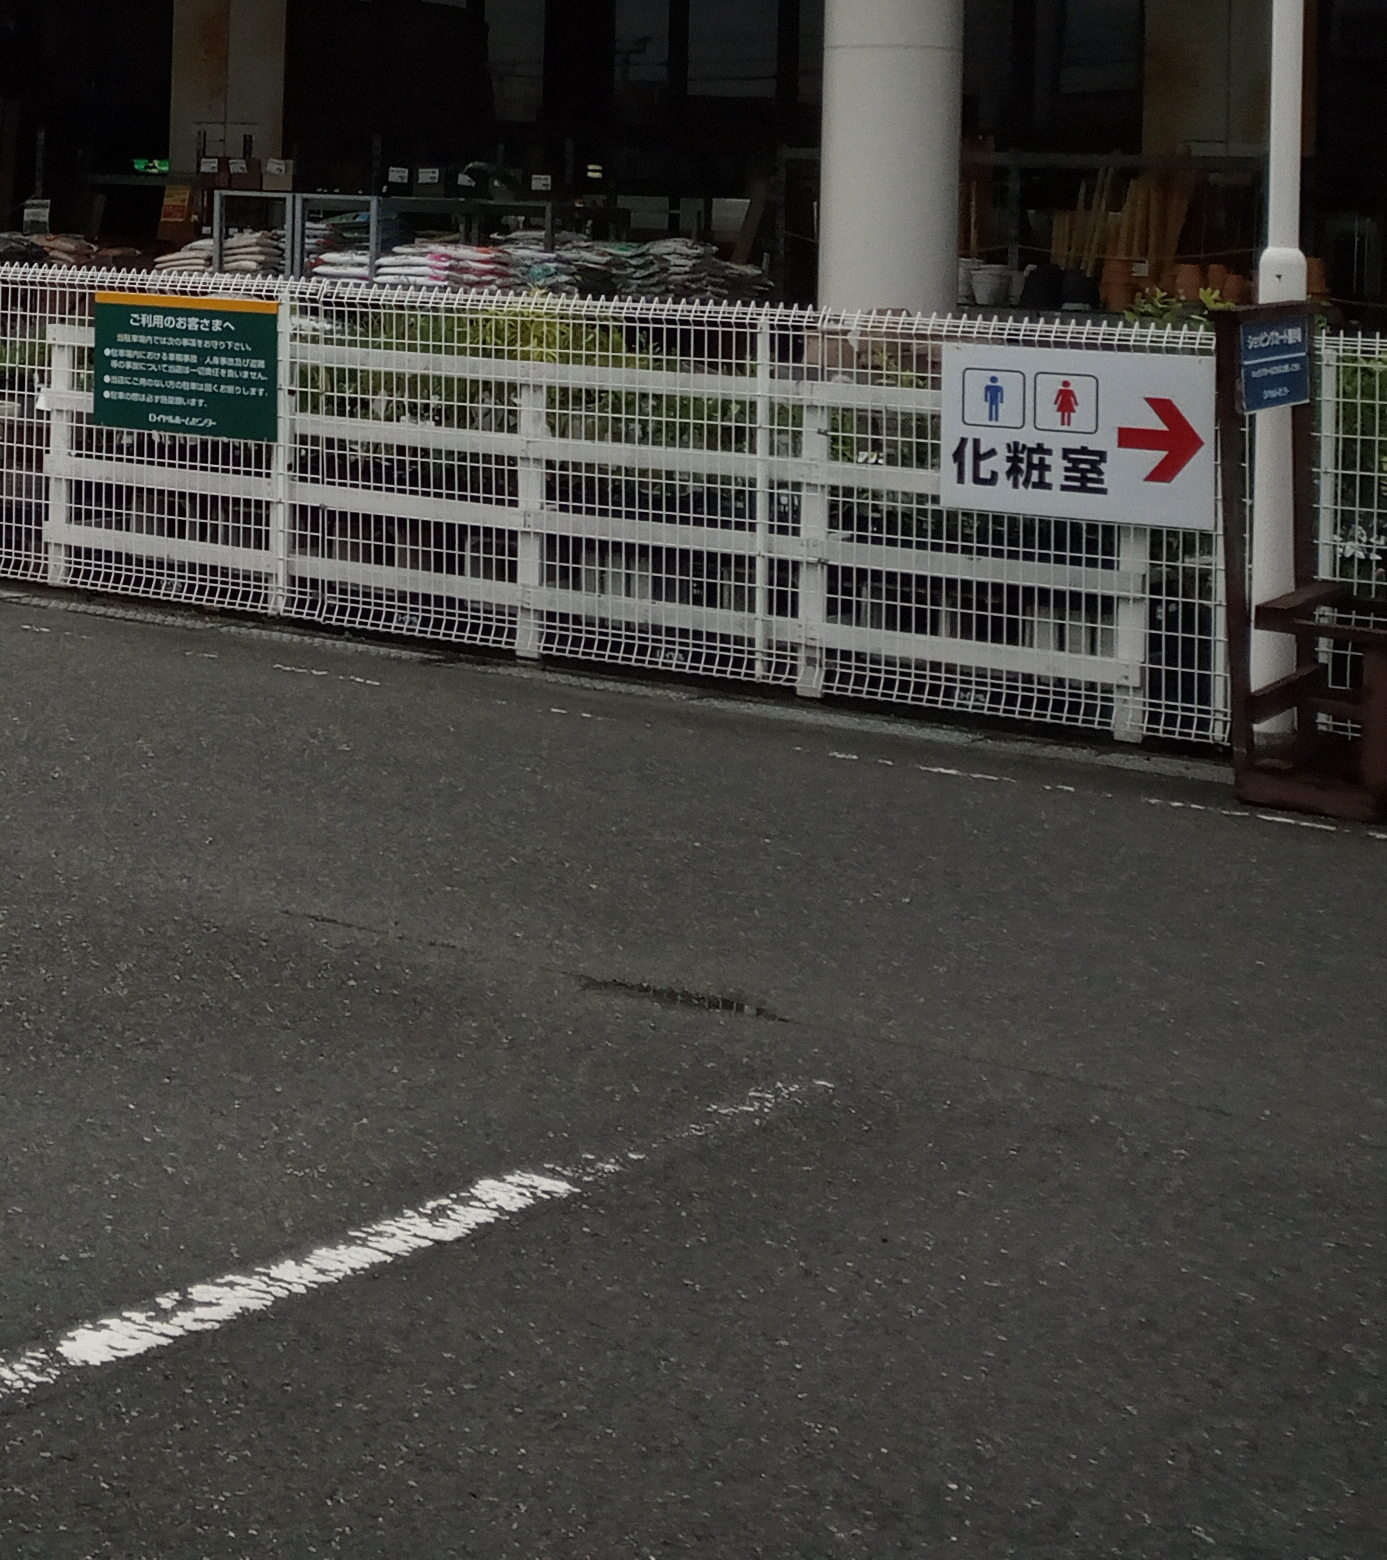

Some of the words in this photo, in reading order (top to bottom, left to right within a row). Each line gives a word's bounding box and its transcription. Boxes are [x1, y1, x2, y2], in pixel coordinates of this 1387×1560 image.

[129, 313, 236, 332] ご利用のお客さまへ
[951, 436, 1109, 496] 化粧室
